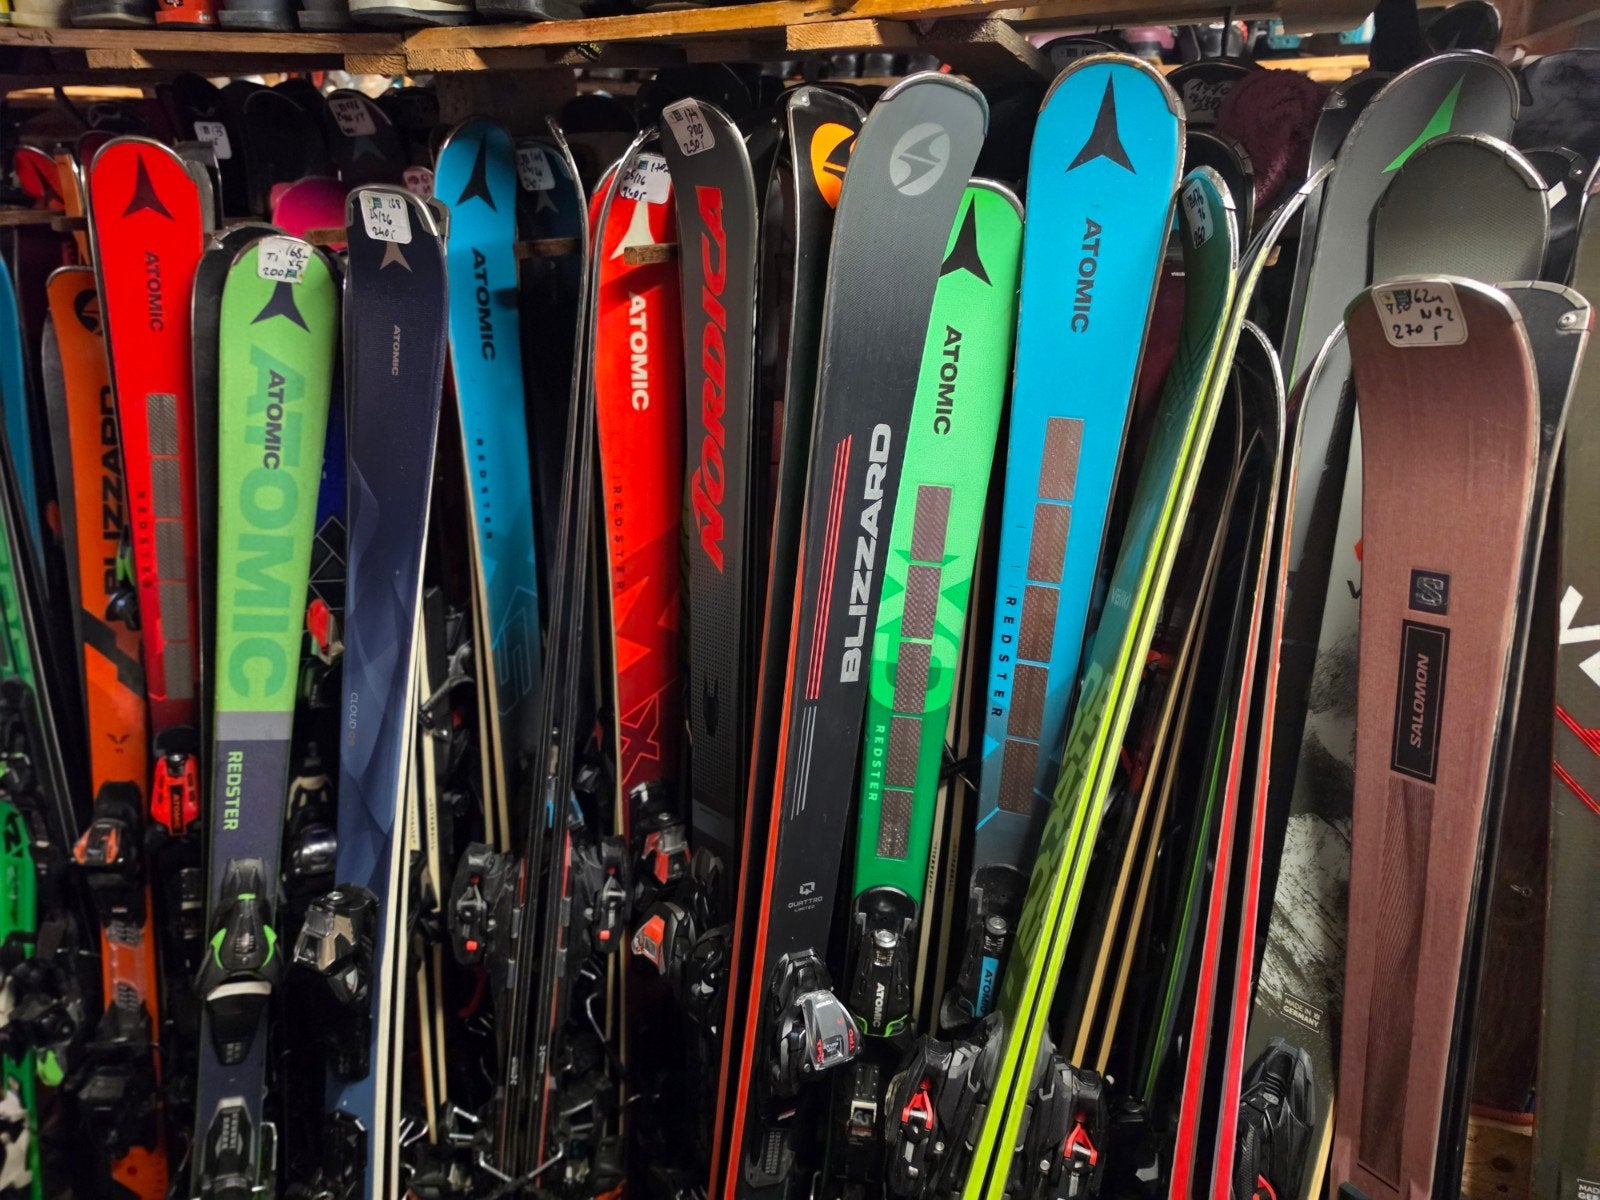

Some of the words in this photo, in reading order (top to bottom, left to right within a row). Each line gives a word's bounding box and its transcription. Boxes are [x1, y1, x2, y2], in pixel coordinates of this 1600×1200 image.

[145, 250, 164, 333] ATOMIC
[471, 248, 496, 362] ATOMIC
[1071, 217, 1102, 334] ATOMIC
[391, 325, 401, 376] ATOMIC
[628, 291, 649, 411] ATOMIC
[692, 186, 727, 574] NORDICA
[933, 325, 963, 436] ATOMIC
[263, 370, 286, 471] ATOMIC
[229, 344, 306, 699] ATOMIC
[476, 438, 493, 540] REDSTER
[612, 485, 625, 591] REDSTER
[840, 423, 891, 683] BLIZZARD
[991, 597, 1017, 718] REDSTER
[1410, 653, 1430, 749] SALOMON
[350, 692, 359, 729] CLOUD
[223, 751, 243, 831] REDSTER
[868, 725, 885, 802] REDSTER
[788, 896, 823, 909] QUATTRO
[873, 982, 885, 1028] ATOMIC
[980, 968, 993, 1017] ATOMIC
[1283, 1005, 1319, 1027] GERMANY
[1285, 998, 1303, 1012] MADE
[1579, 1184, 1600, 1194] MAD
